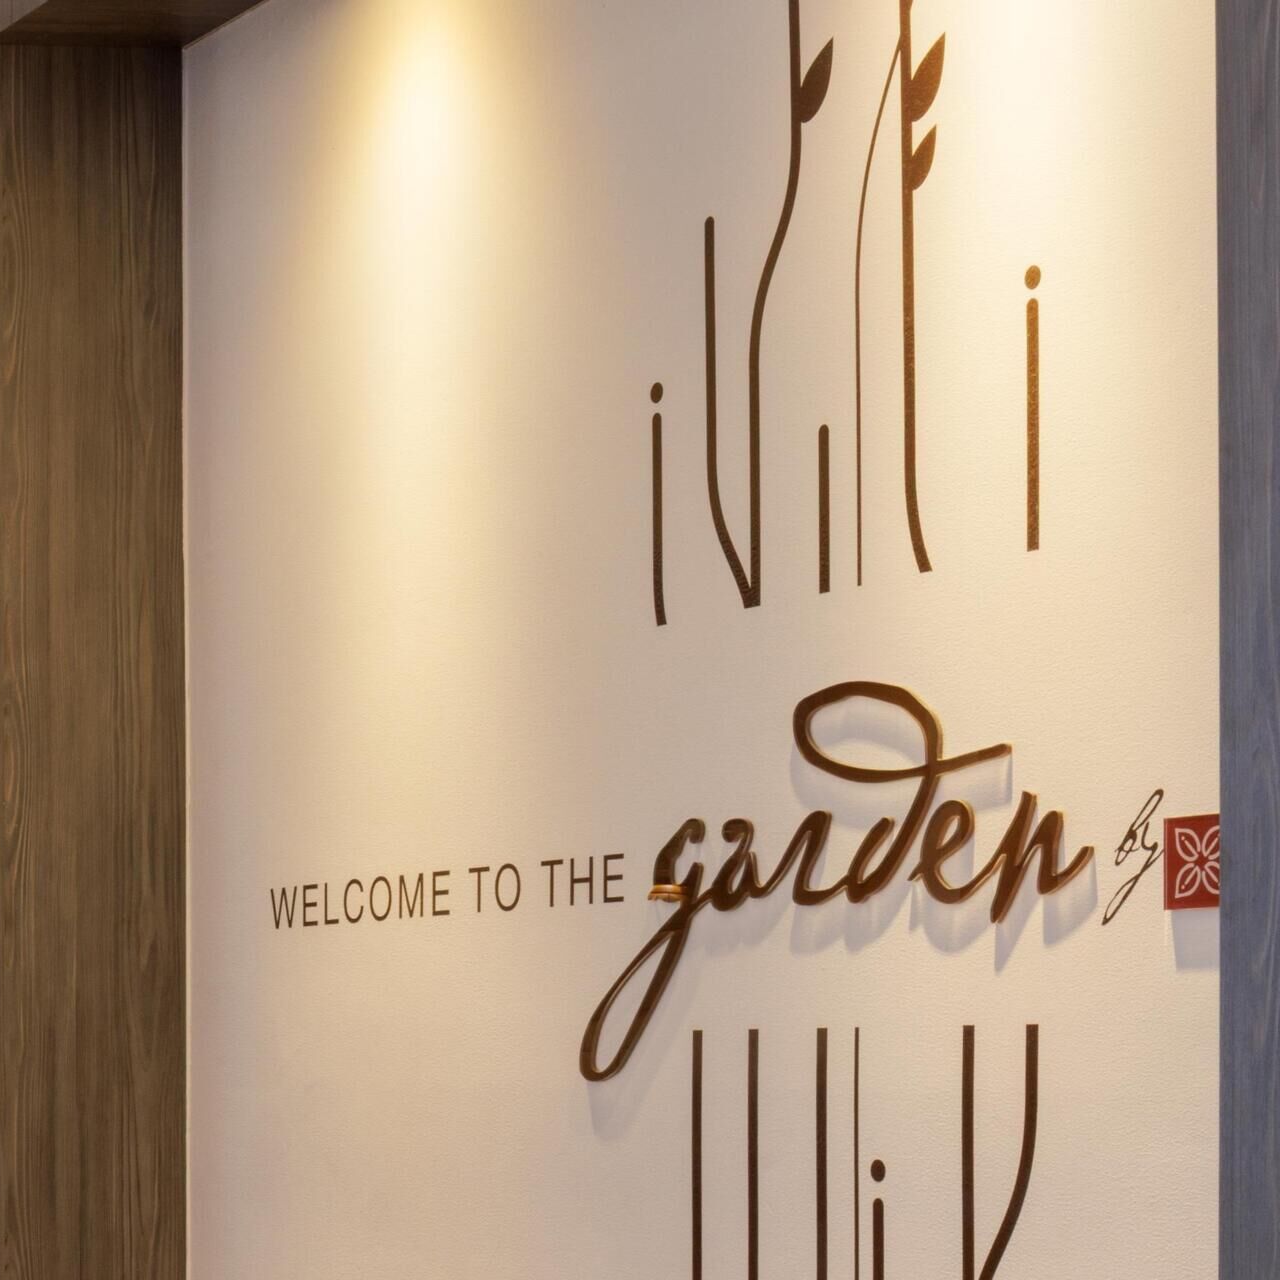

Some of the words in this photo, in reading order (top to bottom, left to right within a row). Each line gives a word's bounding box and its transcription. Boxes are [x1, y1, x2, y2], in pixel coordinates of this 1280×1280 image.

[540, 853, 625, 908] THE
[579, 681, 1096, 1083] garden
[1102, 789, 1164, 926] by
[270, 870, 451, 930] WELCOME
[468, 863, 521, 913] TO
